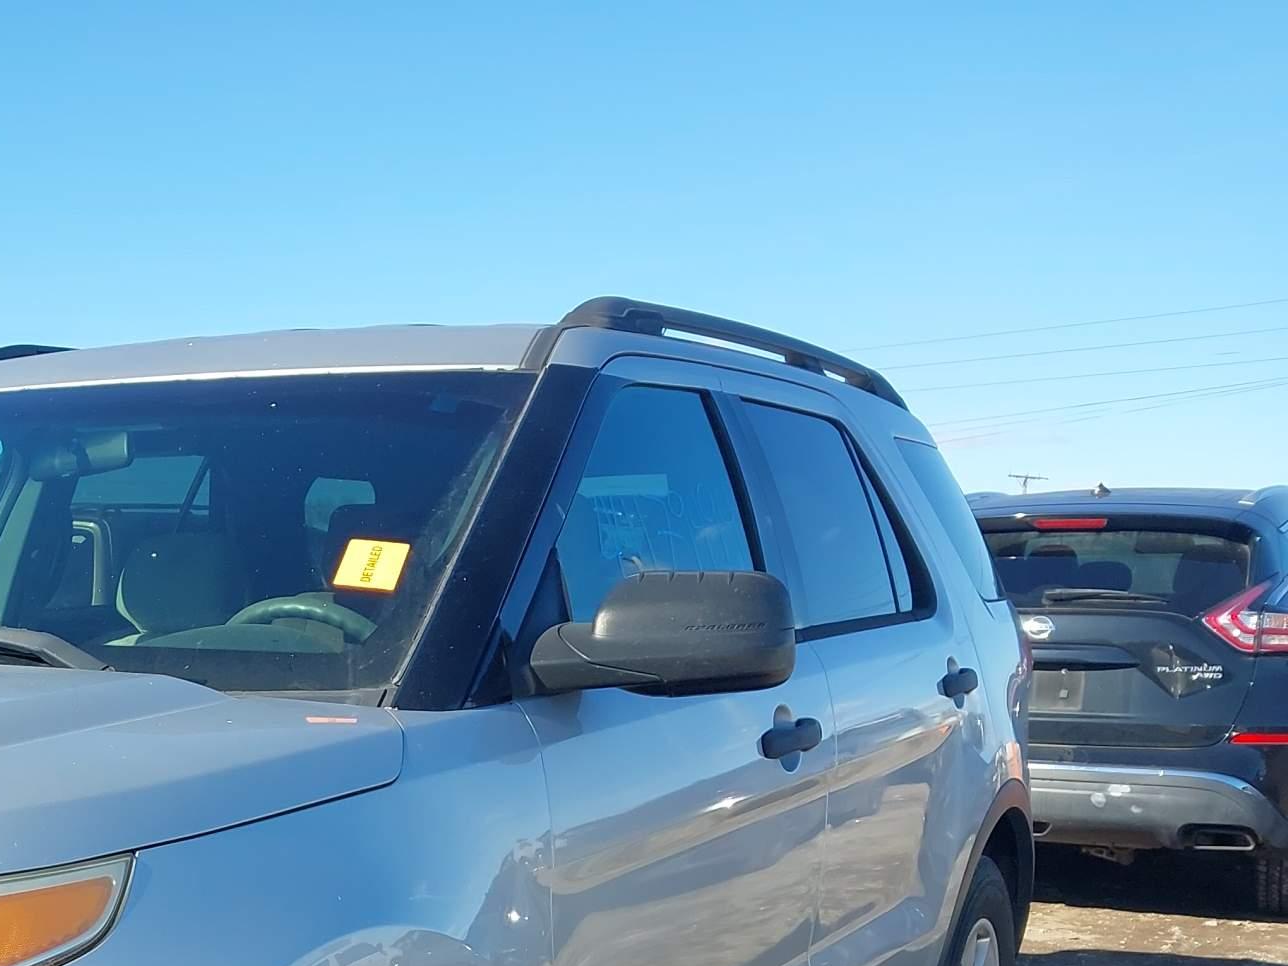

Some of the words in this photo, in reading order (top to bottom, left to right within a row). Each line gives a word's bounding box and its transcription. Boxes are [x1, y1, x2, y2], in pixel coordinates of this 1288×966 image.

[359, 545, 383, 583] DETAILED
[1156, 664, 1223, 673] PLATINUM
[1192, 672, 1223, 680] AWD
